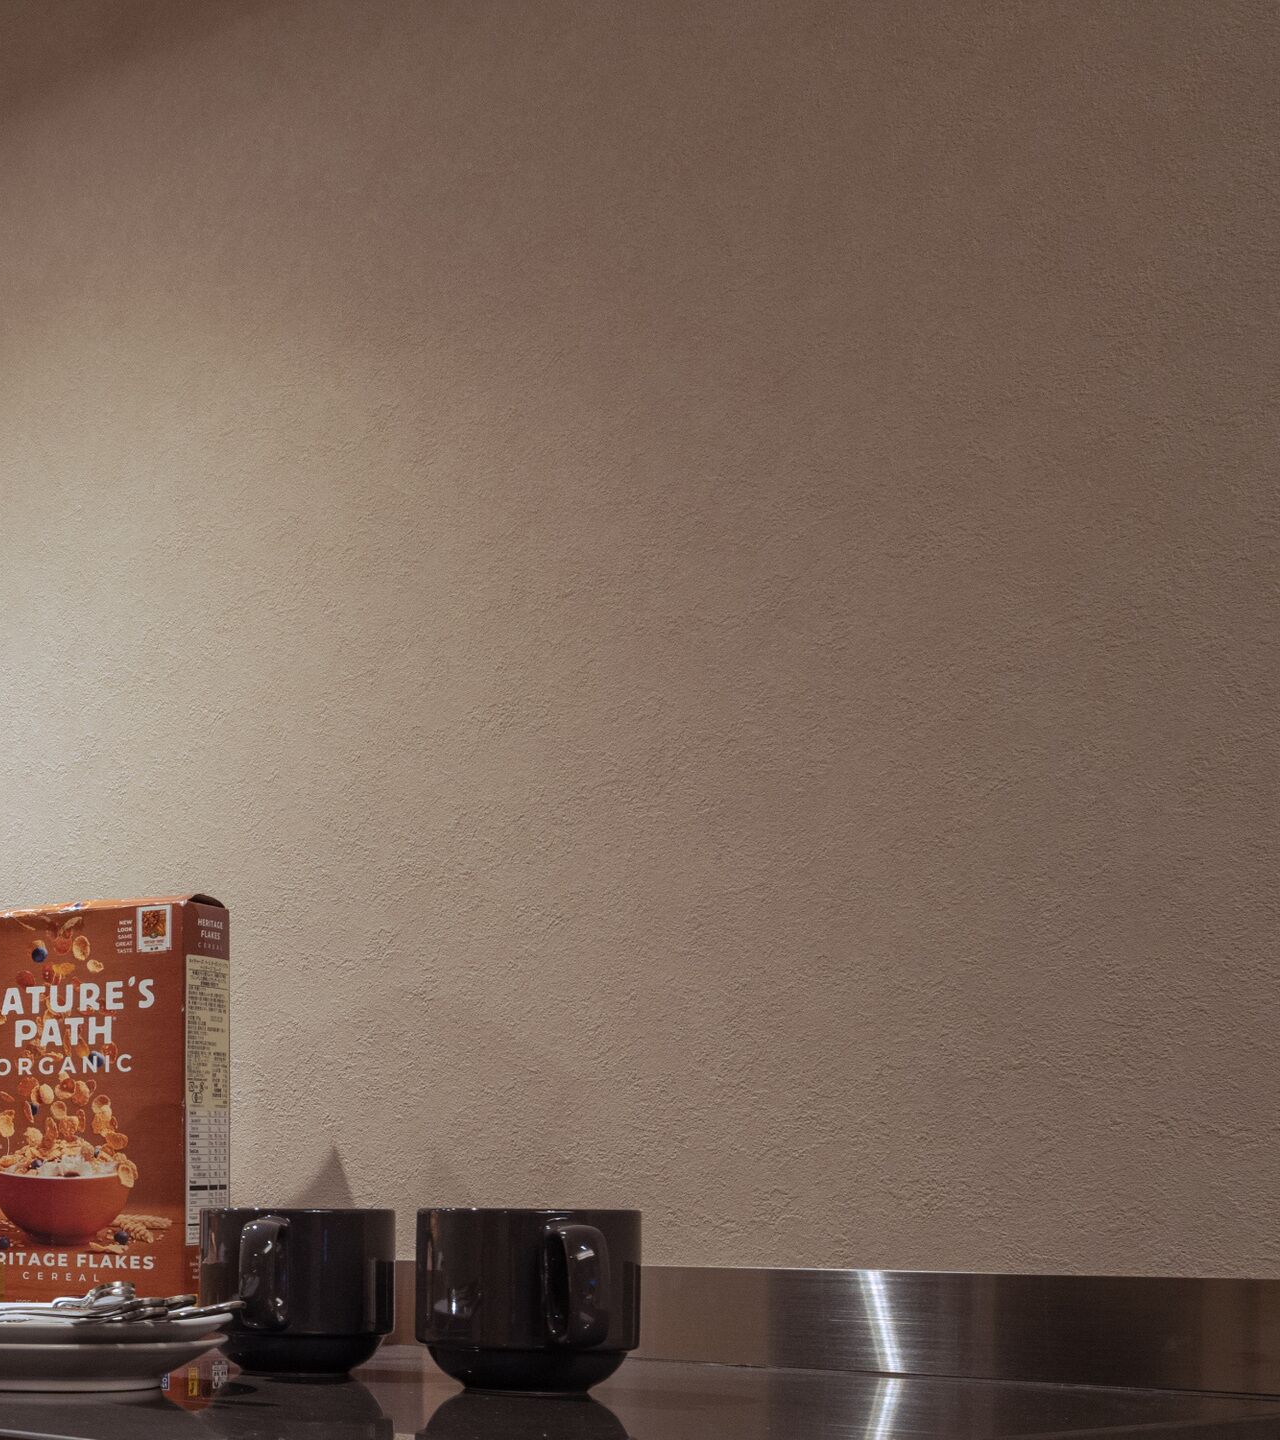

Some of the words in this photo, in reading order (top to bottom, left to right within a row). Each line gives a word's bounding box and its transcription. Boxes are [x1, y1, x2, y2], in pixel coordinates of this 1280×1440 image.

[197, 918, 223, 930] HERITAGE
[200, 929, 221, 940] FLAKES
[115, 940, 132, 948] GREAT
[14, 1016, 113, 1048] PATH
[76, 1253, 155, 1270] FLAKES
[22, 1271, 100, 1283] CEREAL
